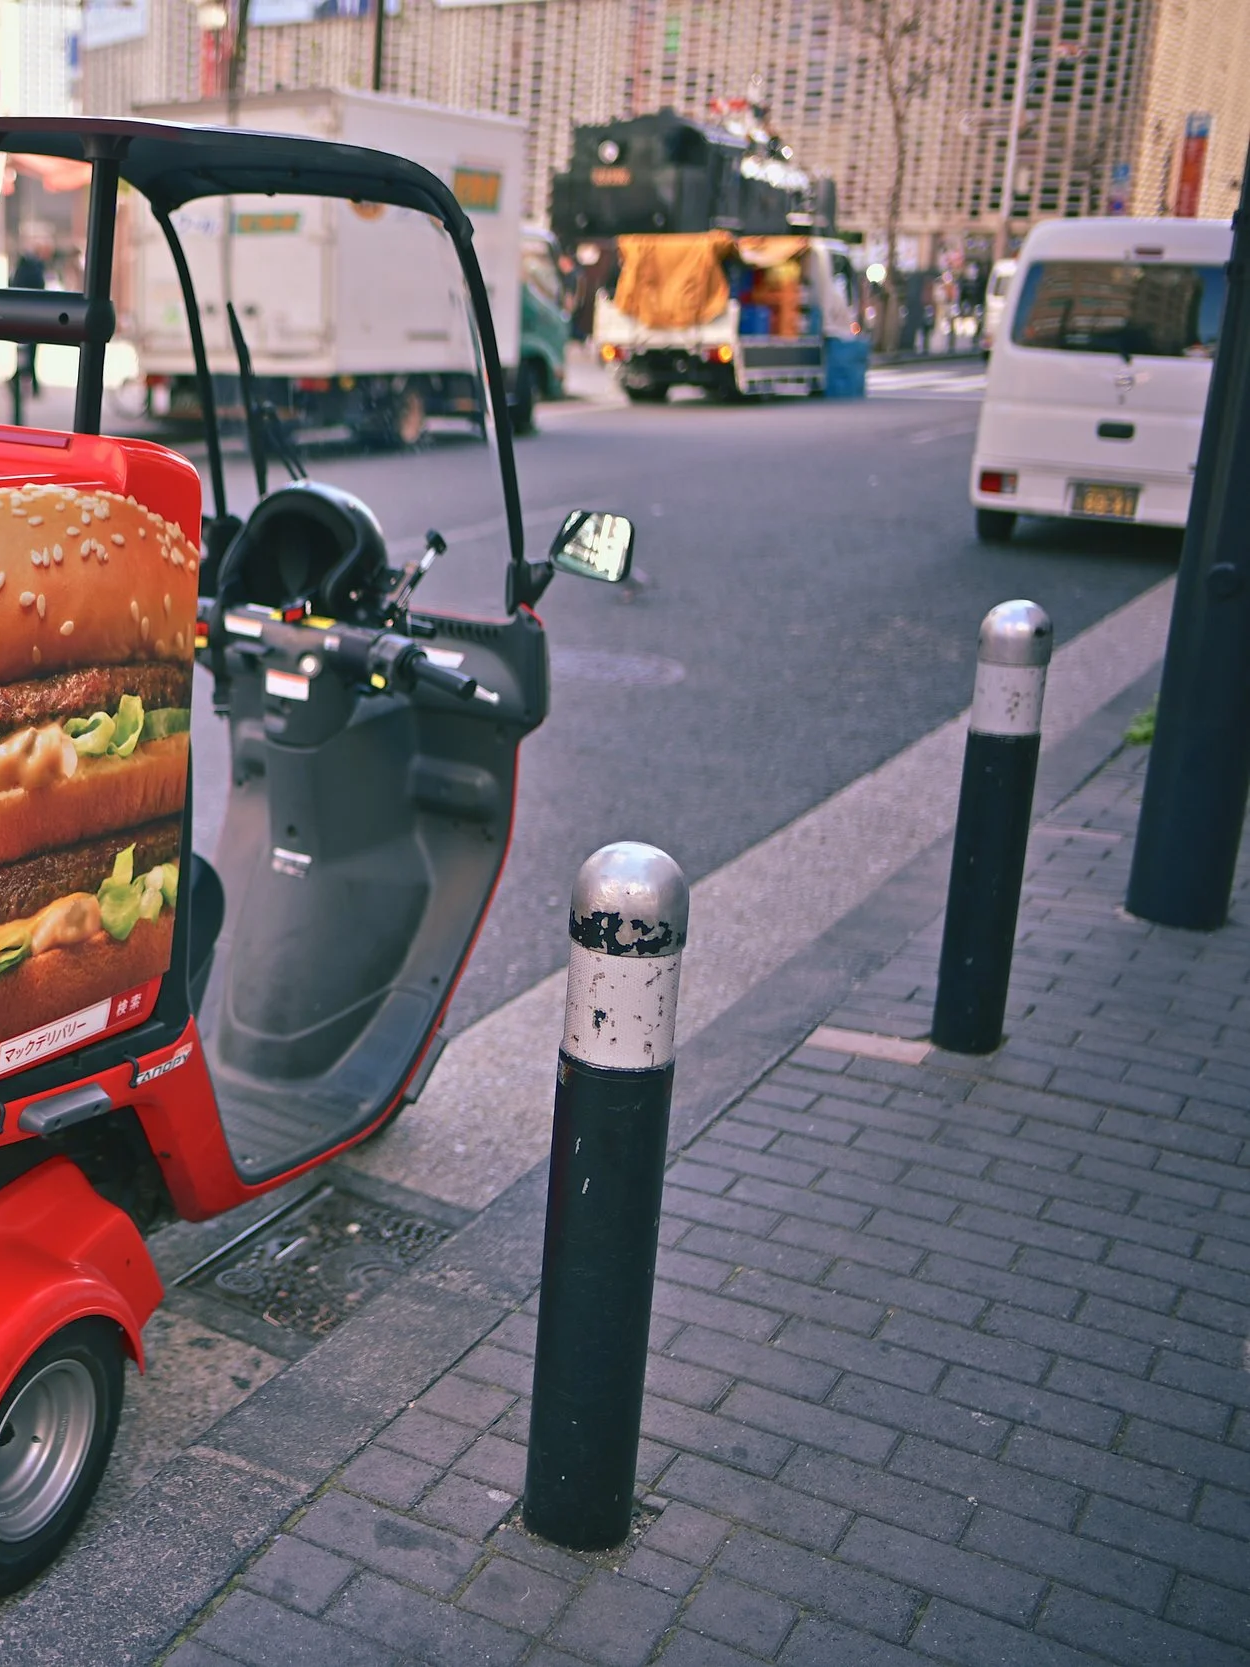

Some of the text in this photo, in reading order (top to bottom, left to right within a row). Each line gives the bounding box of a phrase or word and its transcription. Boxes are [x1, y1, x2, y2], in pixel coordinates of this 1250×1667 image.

[4, 993, 143, 1062] マックデリバリー 検索
